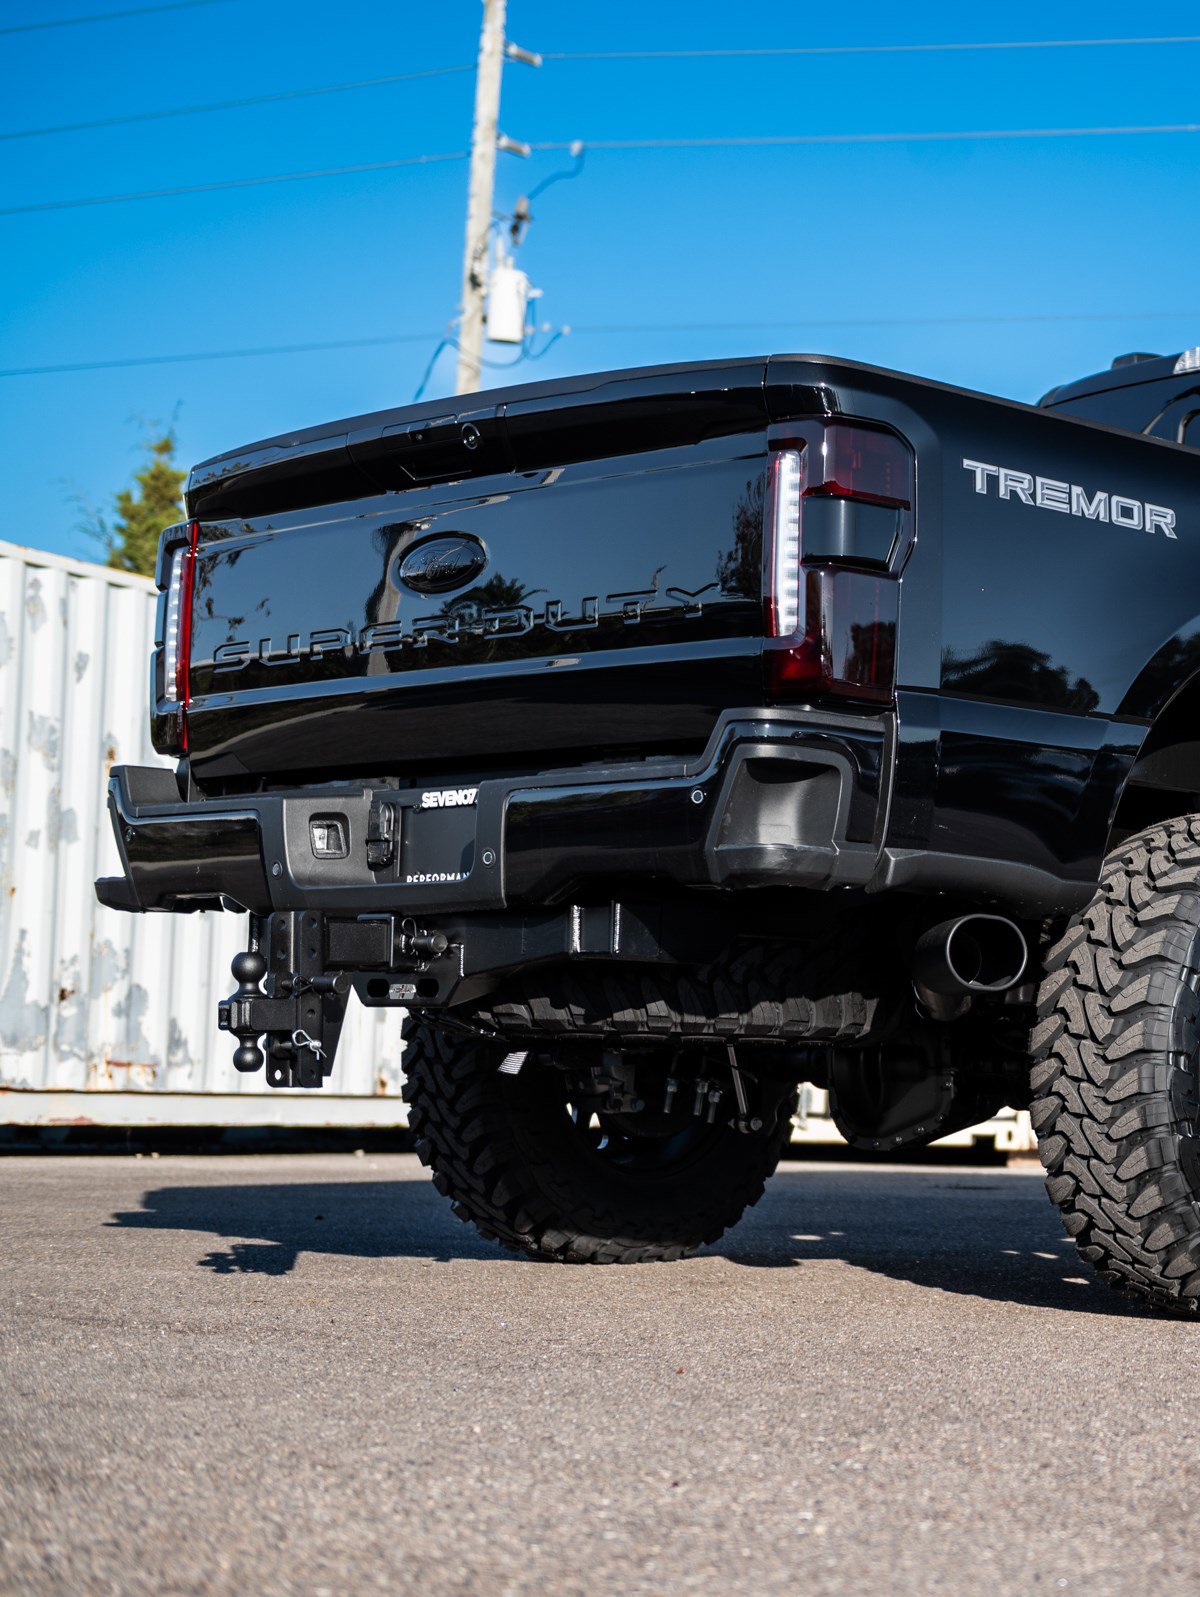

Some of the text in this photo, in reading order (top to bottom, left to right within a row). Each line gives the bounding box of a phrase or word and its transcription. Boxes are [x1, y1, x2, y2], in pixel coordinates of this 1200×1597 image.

[962, 457, 1178, 540] TREMOR
[212, 582, 722, 674] SUPER DUTY
